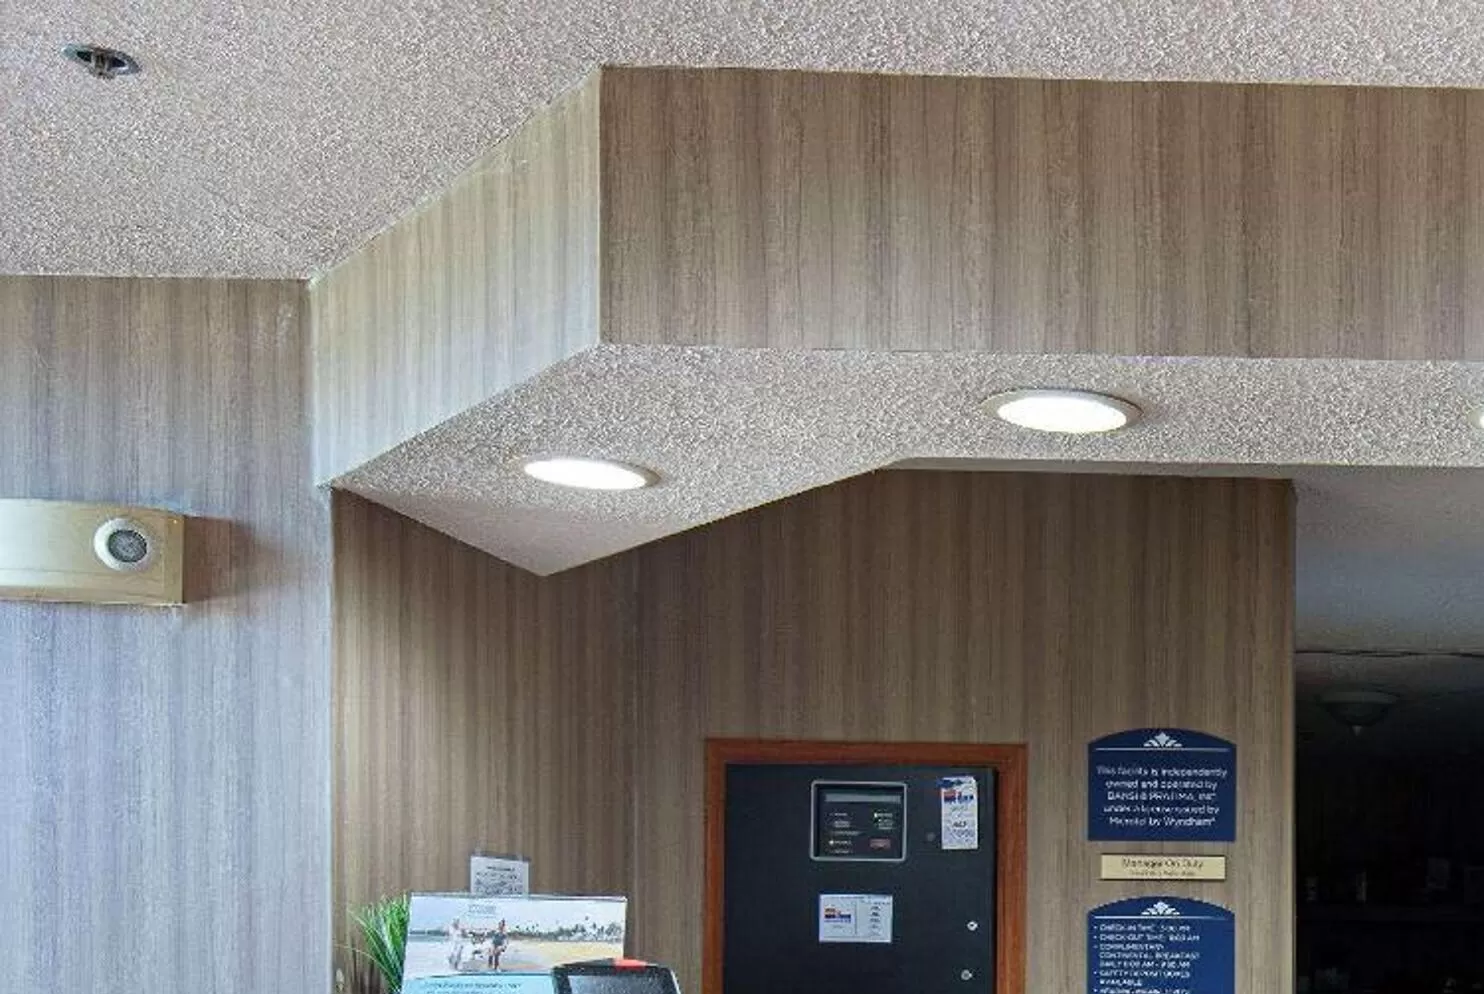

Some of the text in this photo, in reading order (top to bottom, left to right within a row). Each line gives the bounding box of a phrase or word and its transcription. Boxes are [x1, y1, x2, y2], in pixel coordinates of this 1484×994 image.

[1160, 766, 1228, 778] independently
[1140, 780, 1159, 791] and
[1205, 780, 1218, 791] by
